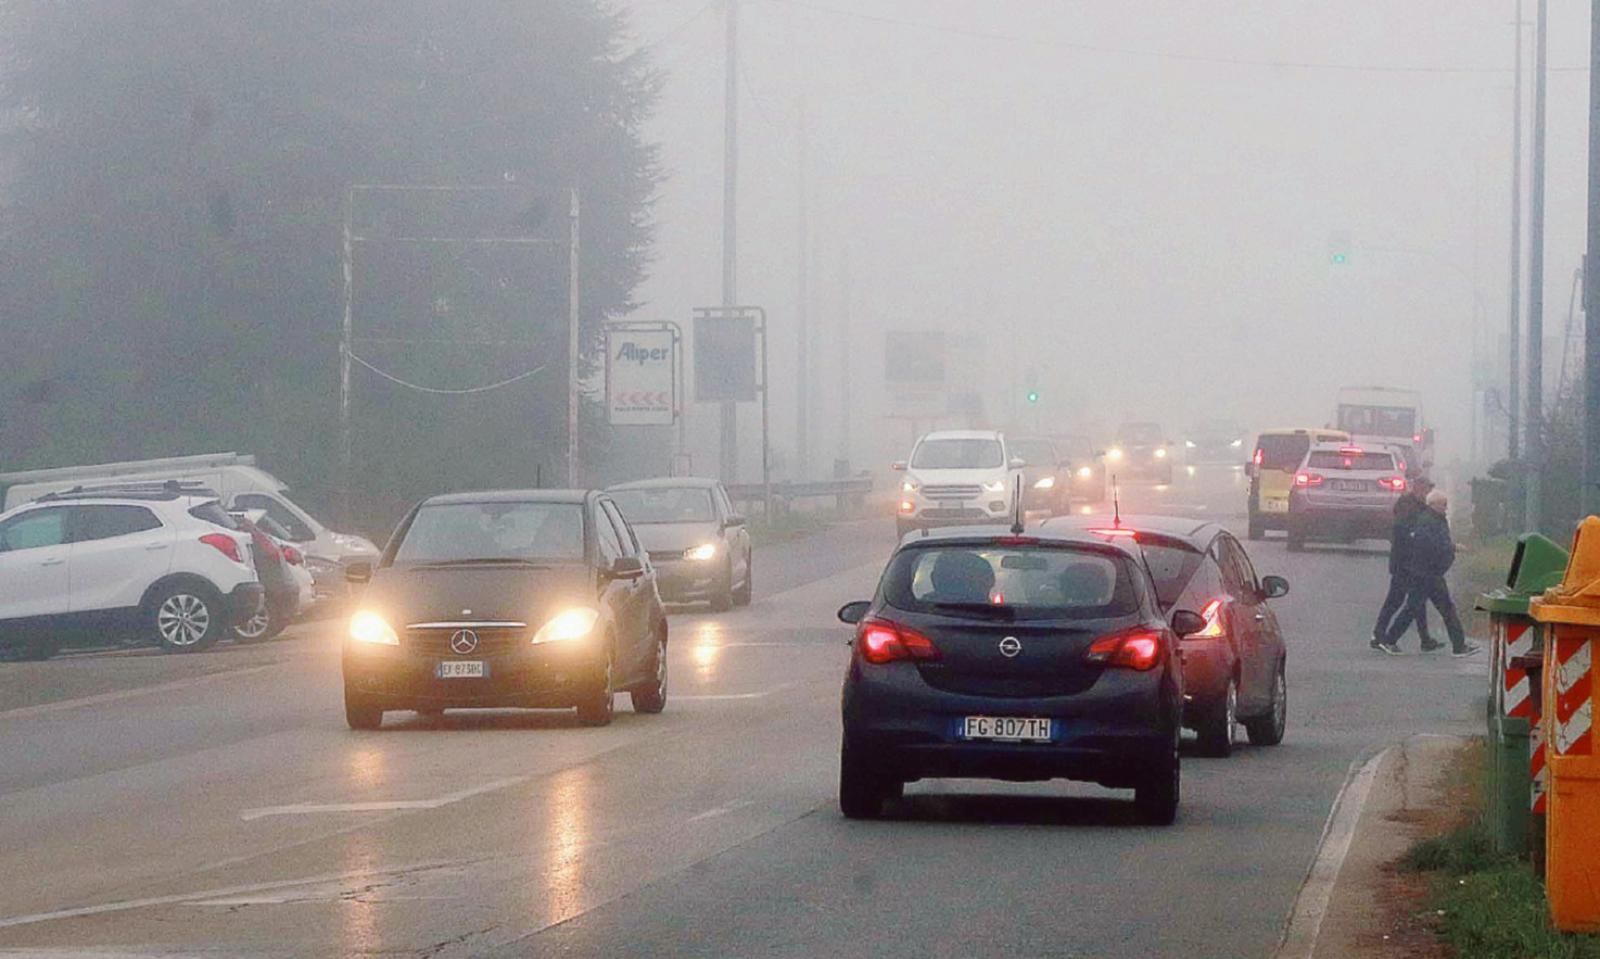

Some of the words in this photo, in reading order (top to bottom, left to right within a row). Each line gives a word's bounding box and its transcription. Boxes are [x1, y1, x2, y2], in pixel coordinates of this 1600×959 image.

[615, 342, 669, 365] Aliper
[967, 718, 988, 735] FG
[994, 718, 1048, 737] 807TH
